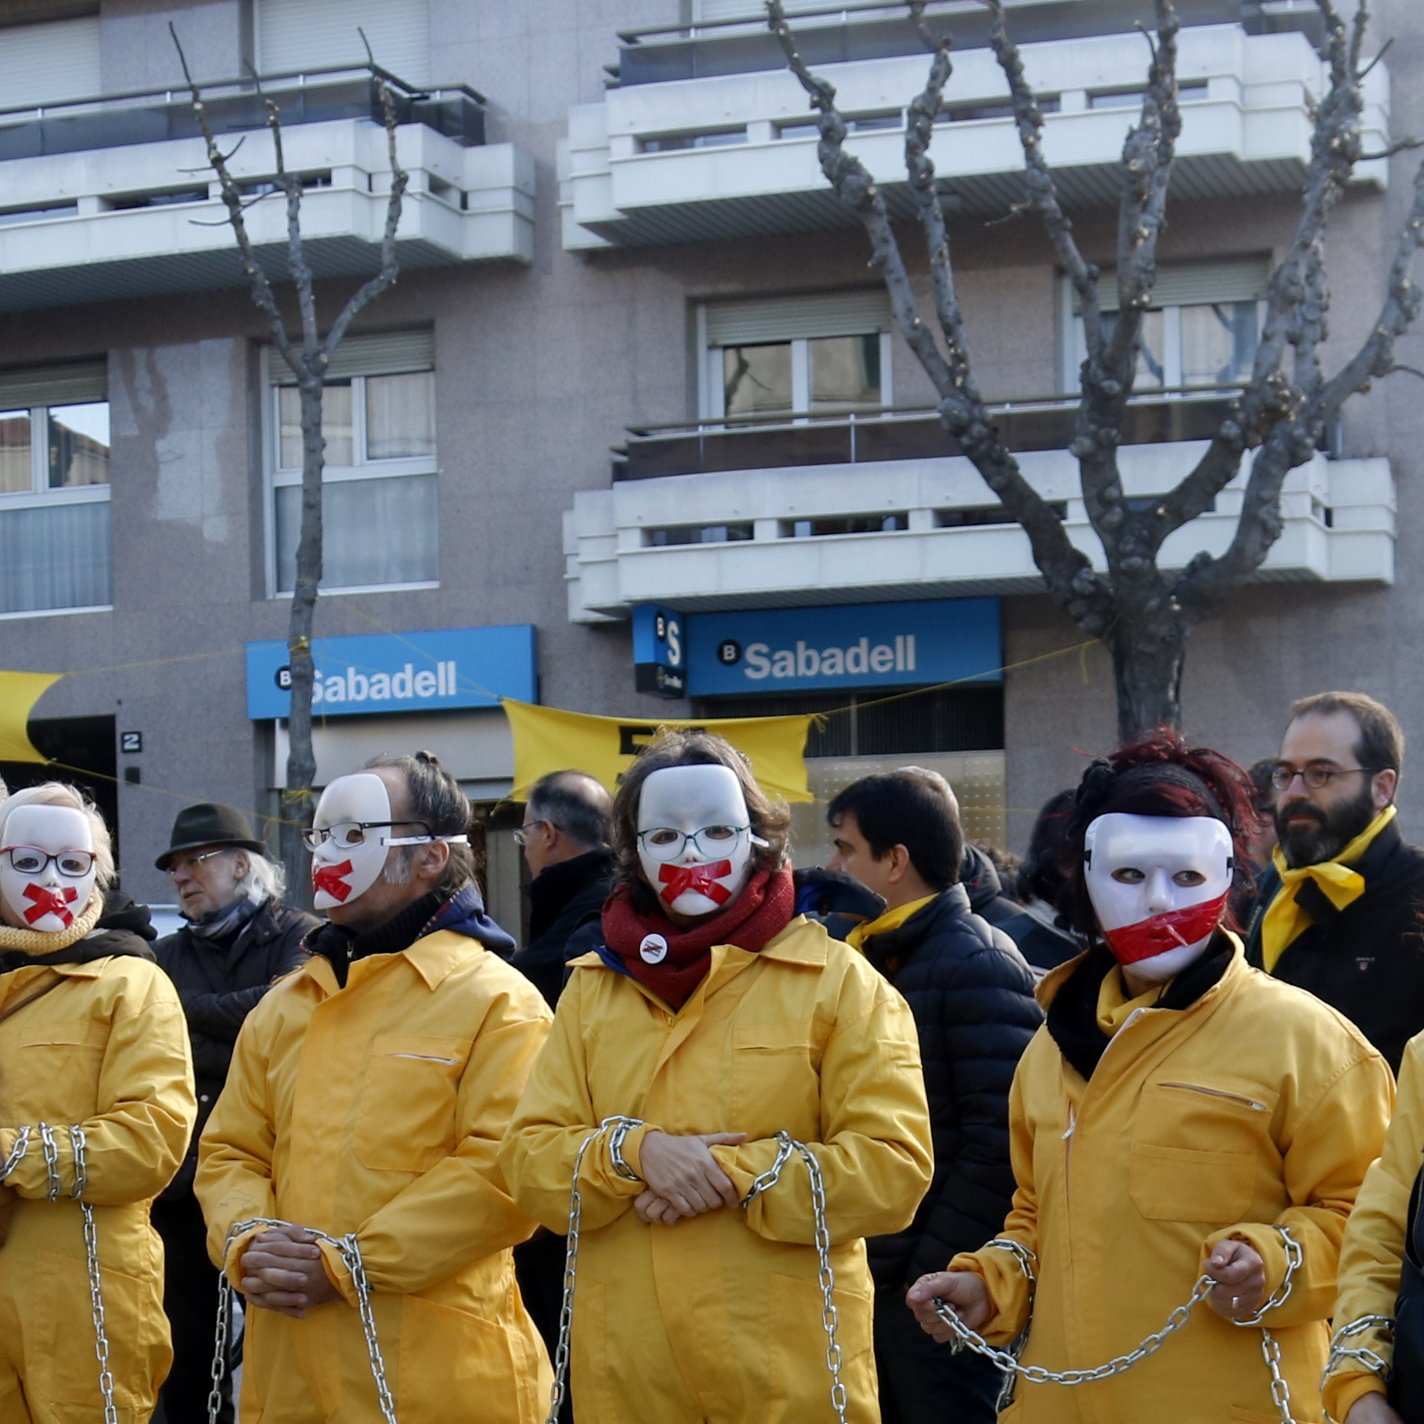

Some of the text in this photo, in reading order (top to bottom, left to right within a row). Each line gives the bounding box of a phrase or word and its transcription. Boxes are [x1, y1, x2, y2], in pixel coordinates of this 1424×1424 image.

[666, 620, 681, 666] S
[722, 634, 916, 680] B Sabadell
[123, 732, 140, 751] 2
